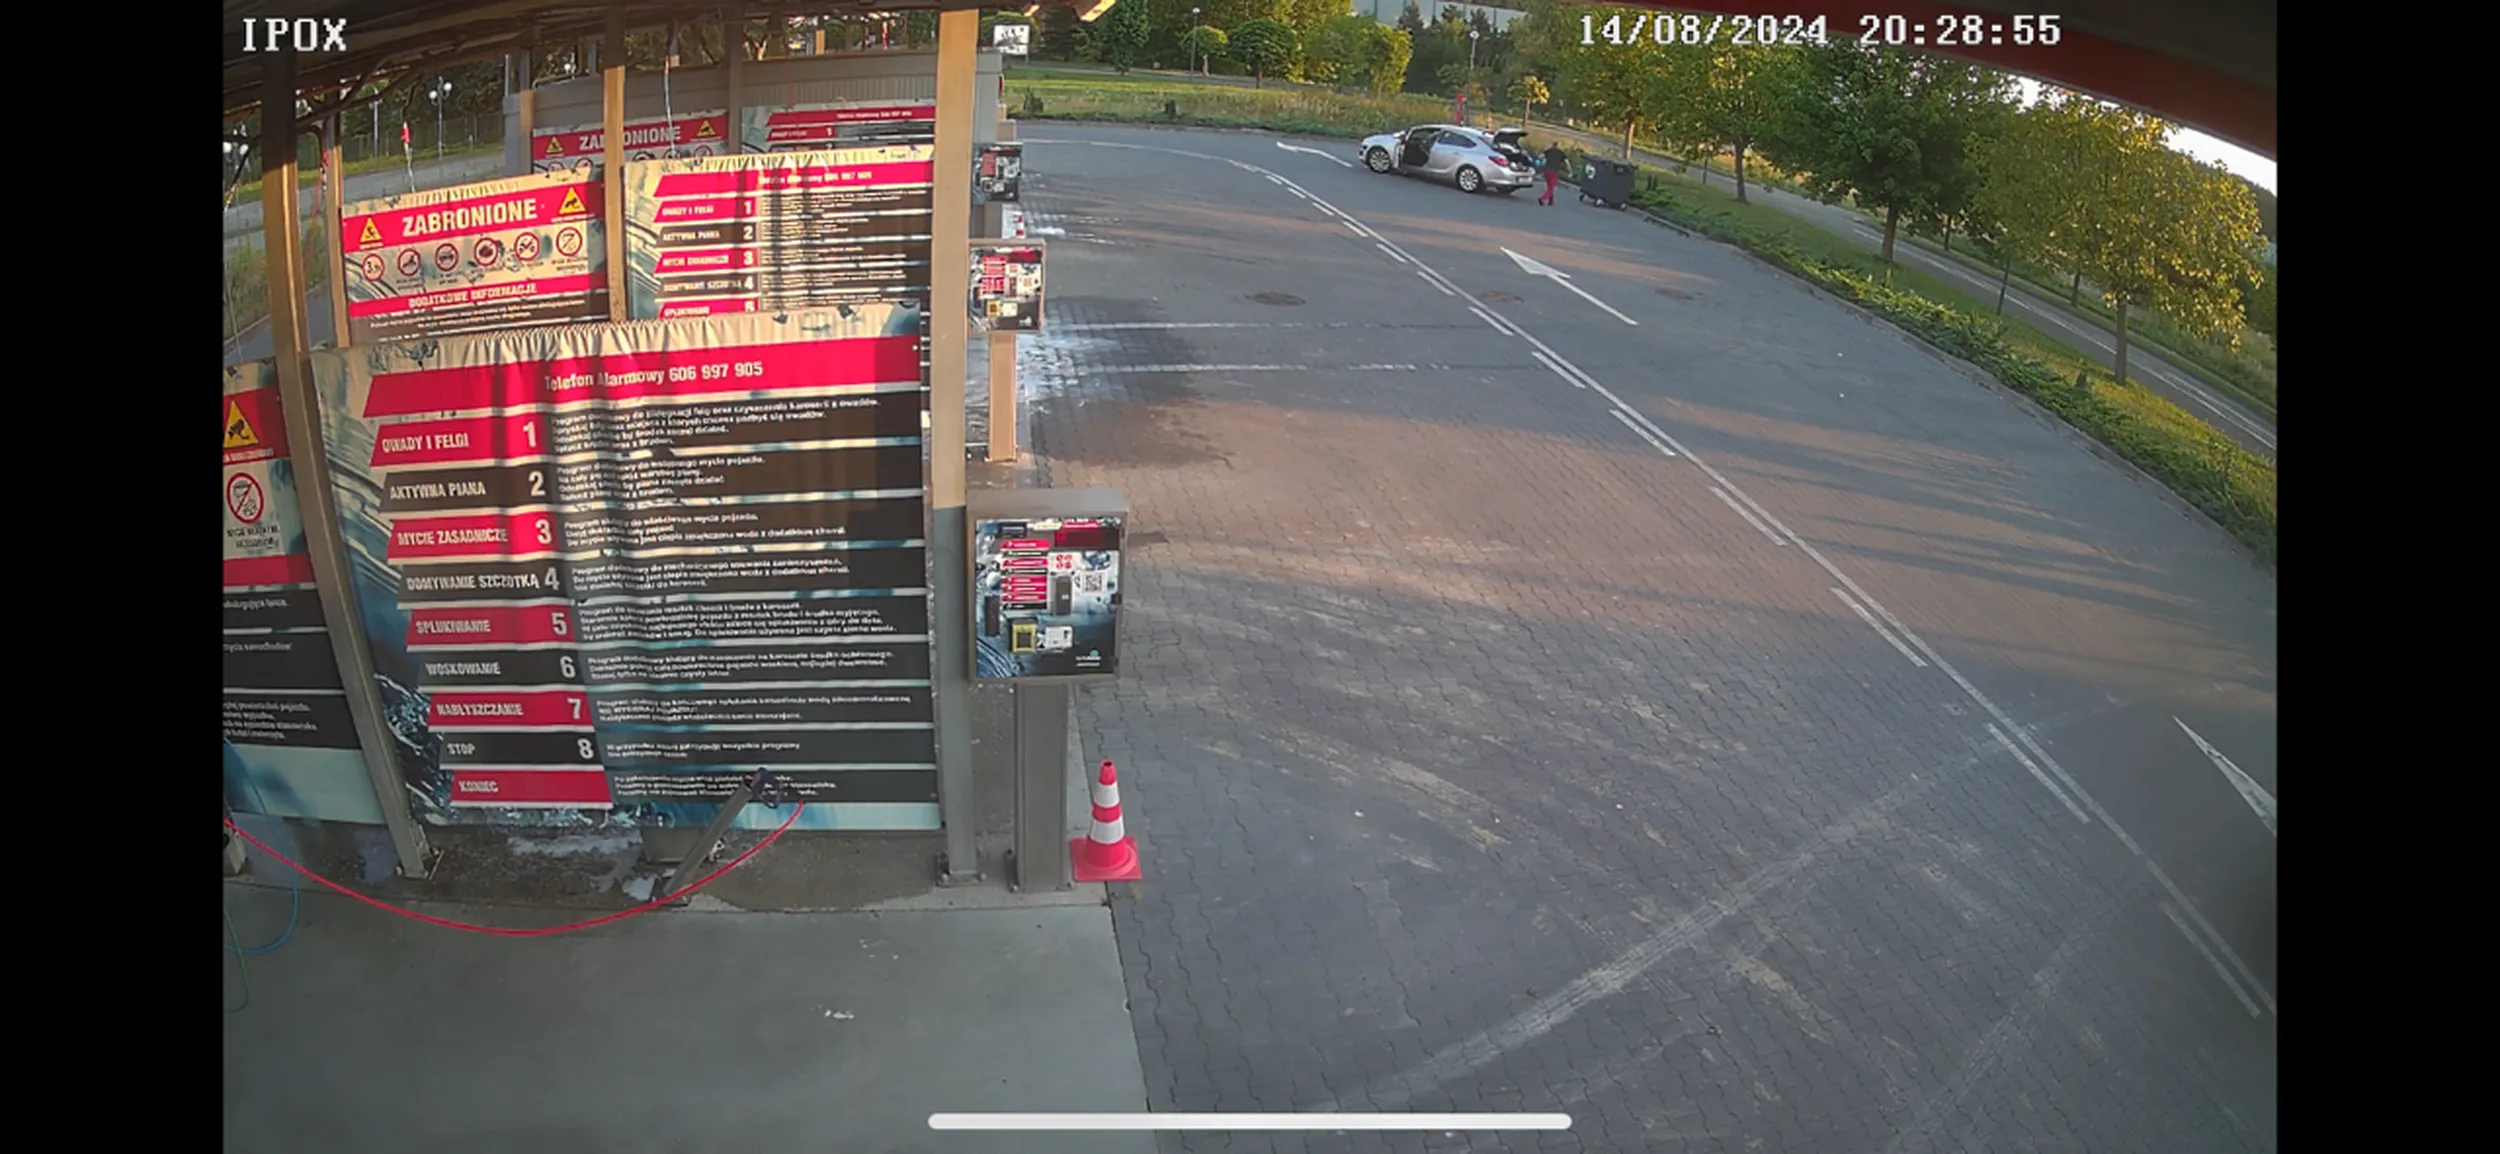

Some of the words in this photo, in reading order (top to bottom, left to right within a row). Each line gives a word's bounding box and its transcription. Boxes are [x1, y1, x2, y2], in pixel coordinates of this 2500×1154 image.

[579, 126, 681, 150] ZAONIONE
[402, 199, 537, 237] ZABRONIONE
[744, 200, 752, 215] 1
[743, 226, 753, 241] 2
[743, 251, 753, 266] 3
[744, 276, 754, 290] 4
[408, 290, 468, 308] DODATKOWE
[471, 283, 537, 300] INFORMACJE
[544, 371, 594, 391] Telefon
[669, 366, 696, 382] 606
[701, 363, 728, 379] 997
[734, 361, 763, 377] 905
[382, 433, 422, 453] OWADY
[426, 435, 432, 449] I
[435, 432, 469, 448] FELGI
[523, 421, 537, 448] 1
[389, 483, 446, 500] AKTYWNA
[449, 481, 486, 497] PIANA
[528, 471, 546, 497] 2
[397, 531, 434, 546] MYCIE
[437, 528, 508, 545] ZASADNICZE
[535, 519, 552, 545] 3
[407, 575, 475, 591] DOMYWANIE
[479, 574, 540, 589] SZCZOTKĄ
[544, 567, 560, 590] 4
[551, 612, 567, 635] 5
[425, 662, 501, 676] WOSKOWANIE
[559, 655, 576, 678] 6
[567, 698, 582, 720] 7
[447, 743, 475, 756] STOP
[577, 738, 594, 760] 8
[458, 780, 499, 794] KONIEC
